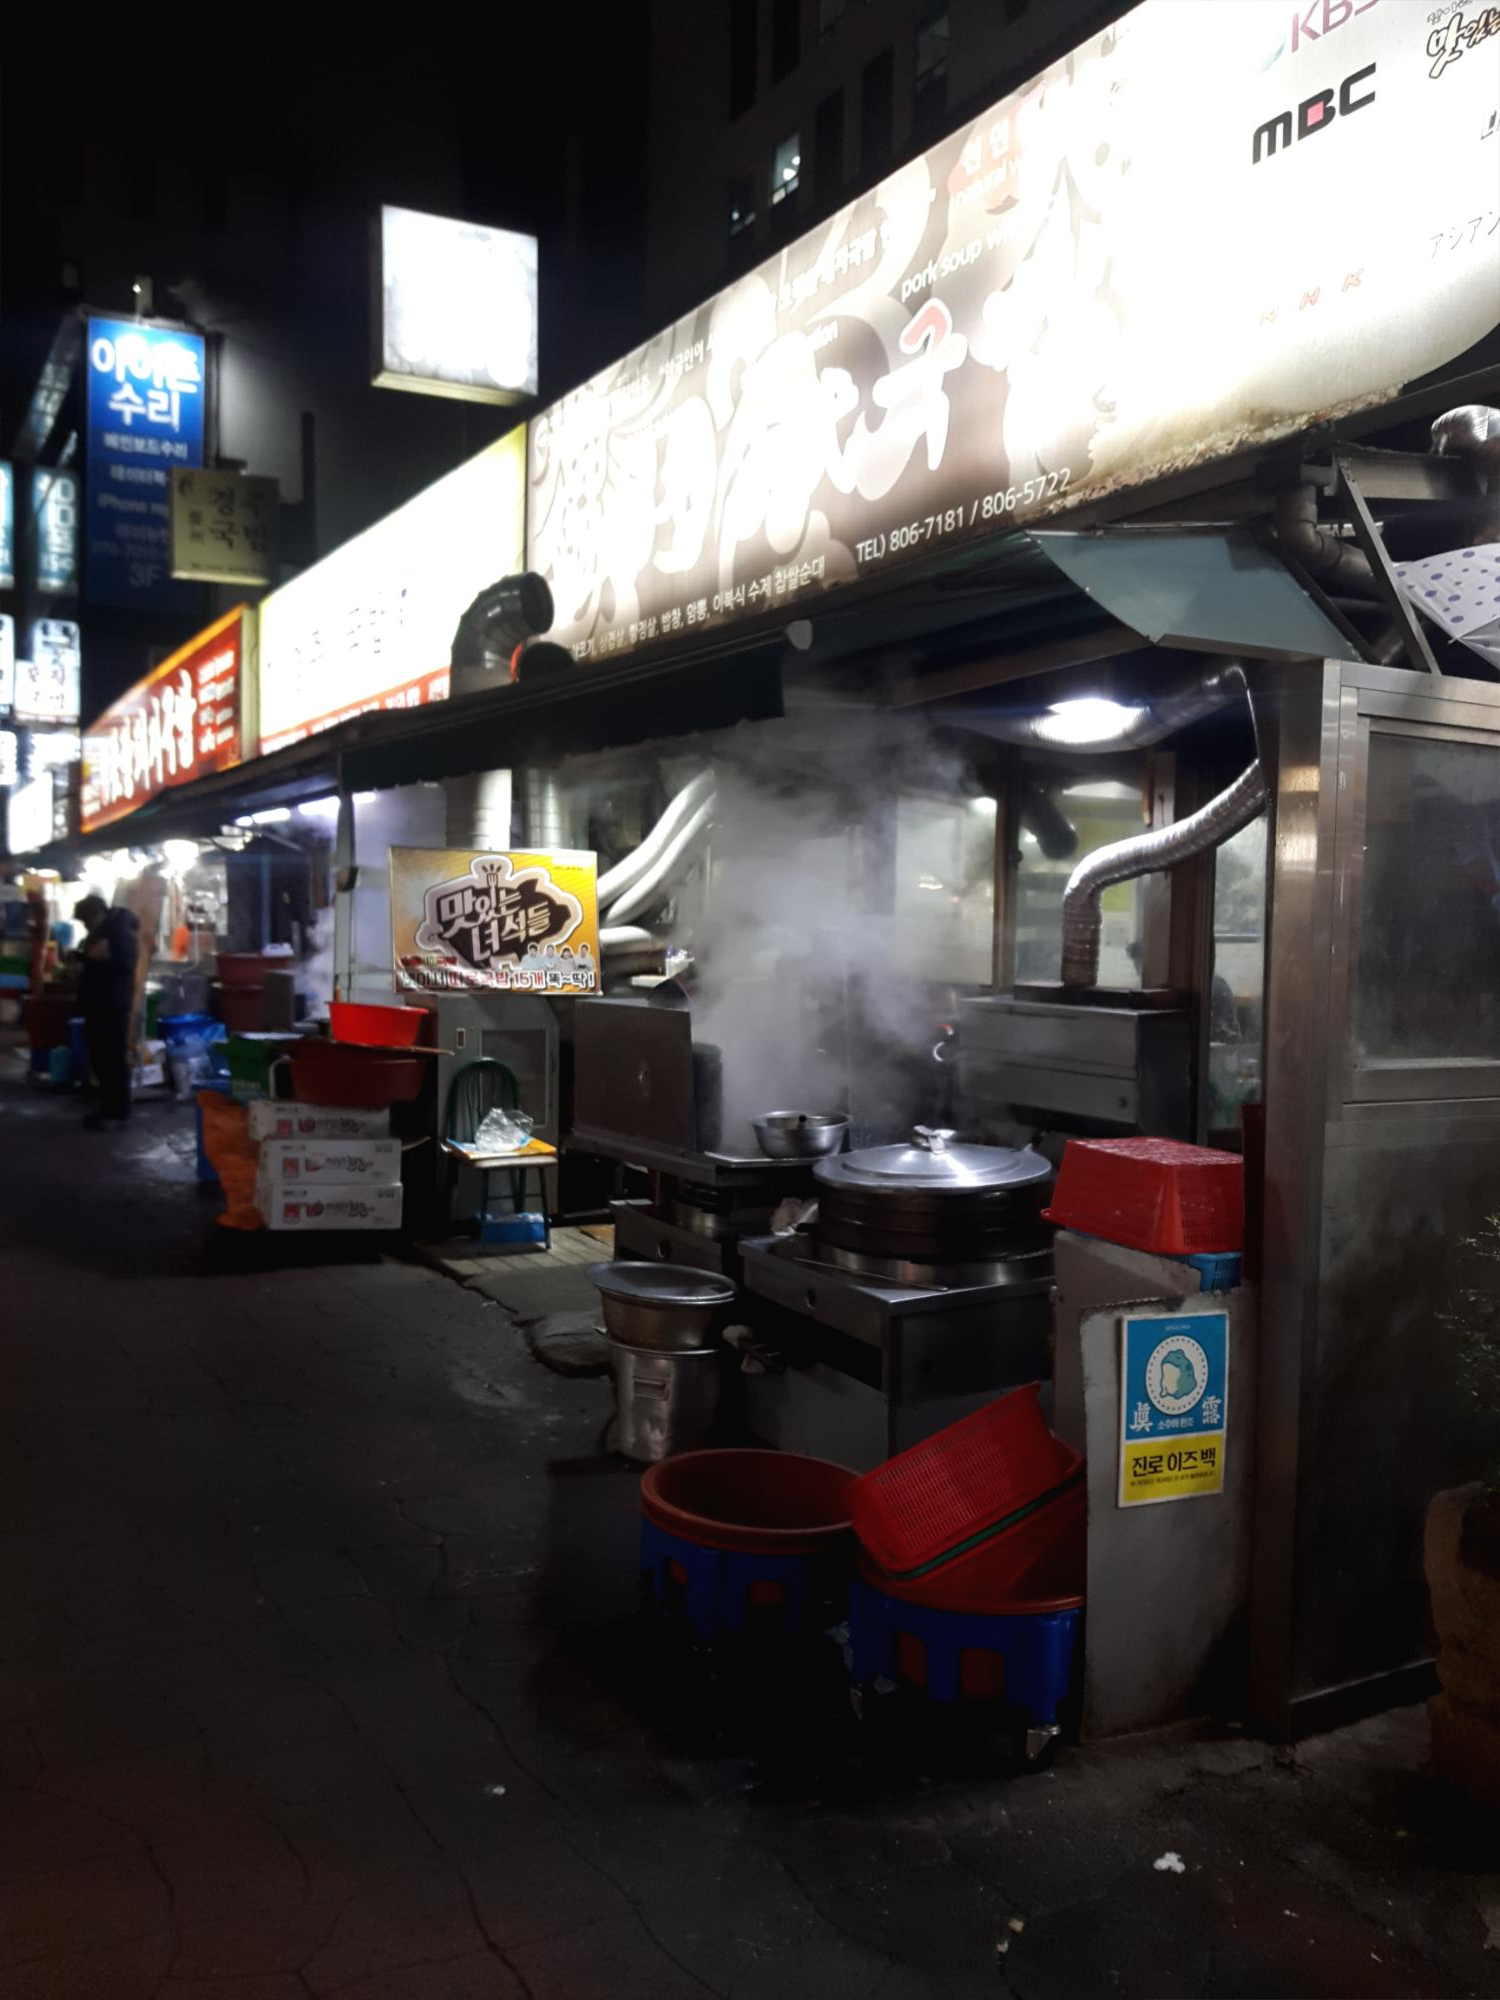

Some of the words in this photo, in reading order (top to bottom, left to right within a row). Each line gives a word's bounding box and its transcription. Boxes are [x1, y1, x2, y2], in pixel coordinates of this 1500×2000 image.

[1291, 0, 1380, 53] KB
[901, 259, 938, 303] pork
[940, 236, 983, 278] soup
[108, 382, 181, 433] 수리
[889, 504, 964, 552] 806-7181
[981, 467, 1072, 519] 806-5722
[712, 582, 746, 614] 이북식
[748, 574, 773, 604] 수제
[774, 554, 825, 596] 찹쌀순대
[439, 884, 522, 938] 맛있는
[471, 900, 552, 962] 녀석들
[1131, 1452, 1164, 1478] 진로
[1166, 1449, 1199, 1473] 이즈
[1200, 1446, 1217, 1468] 백
